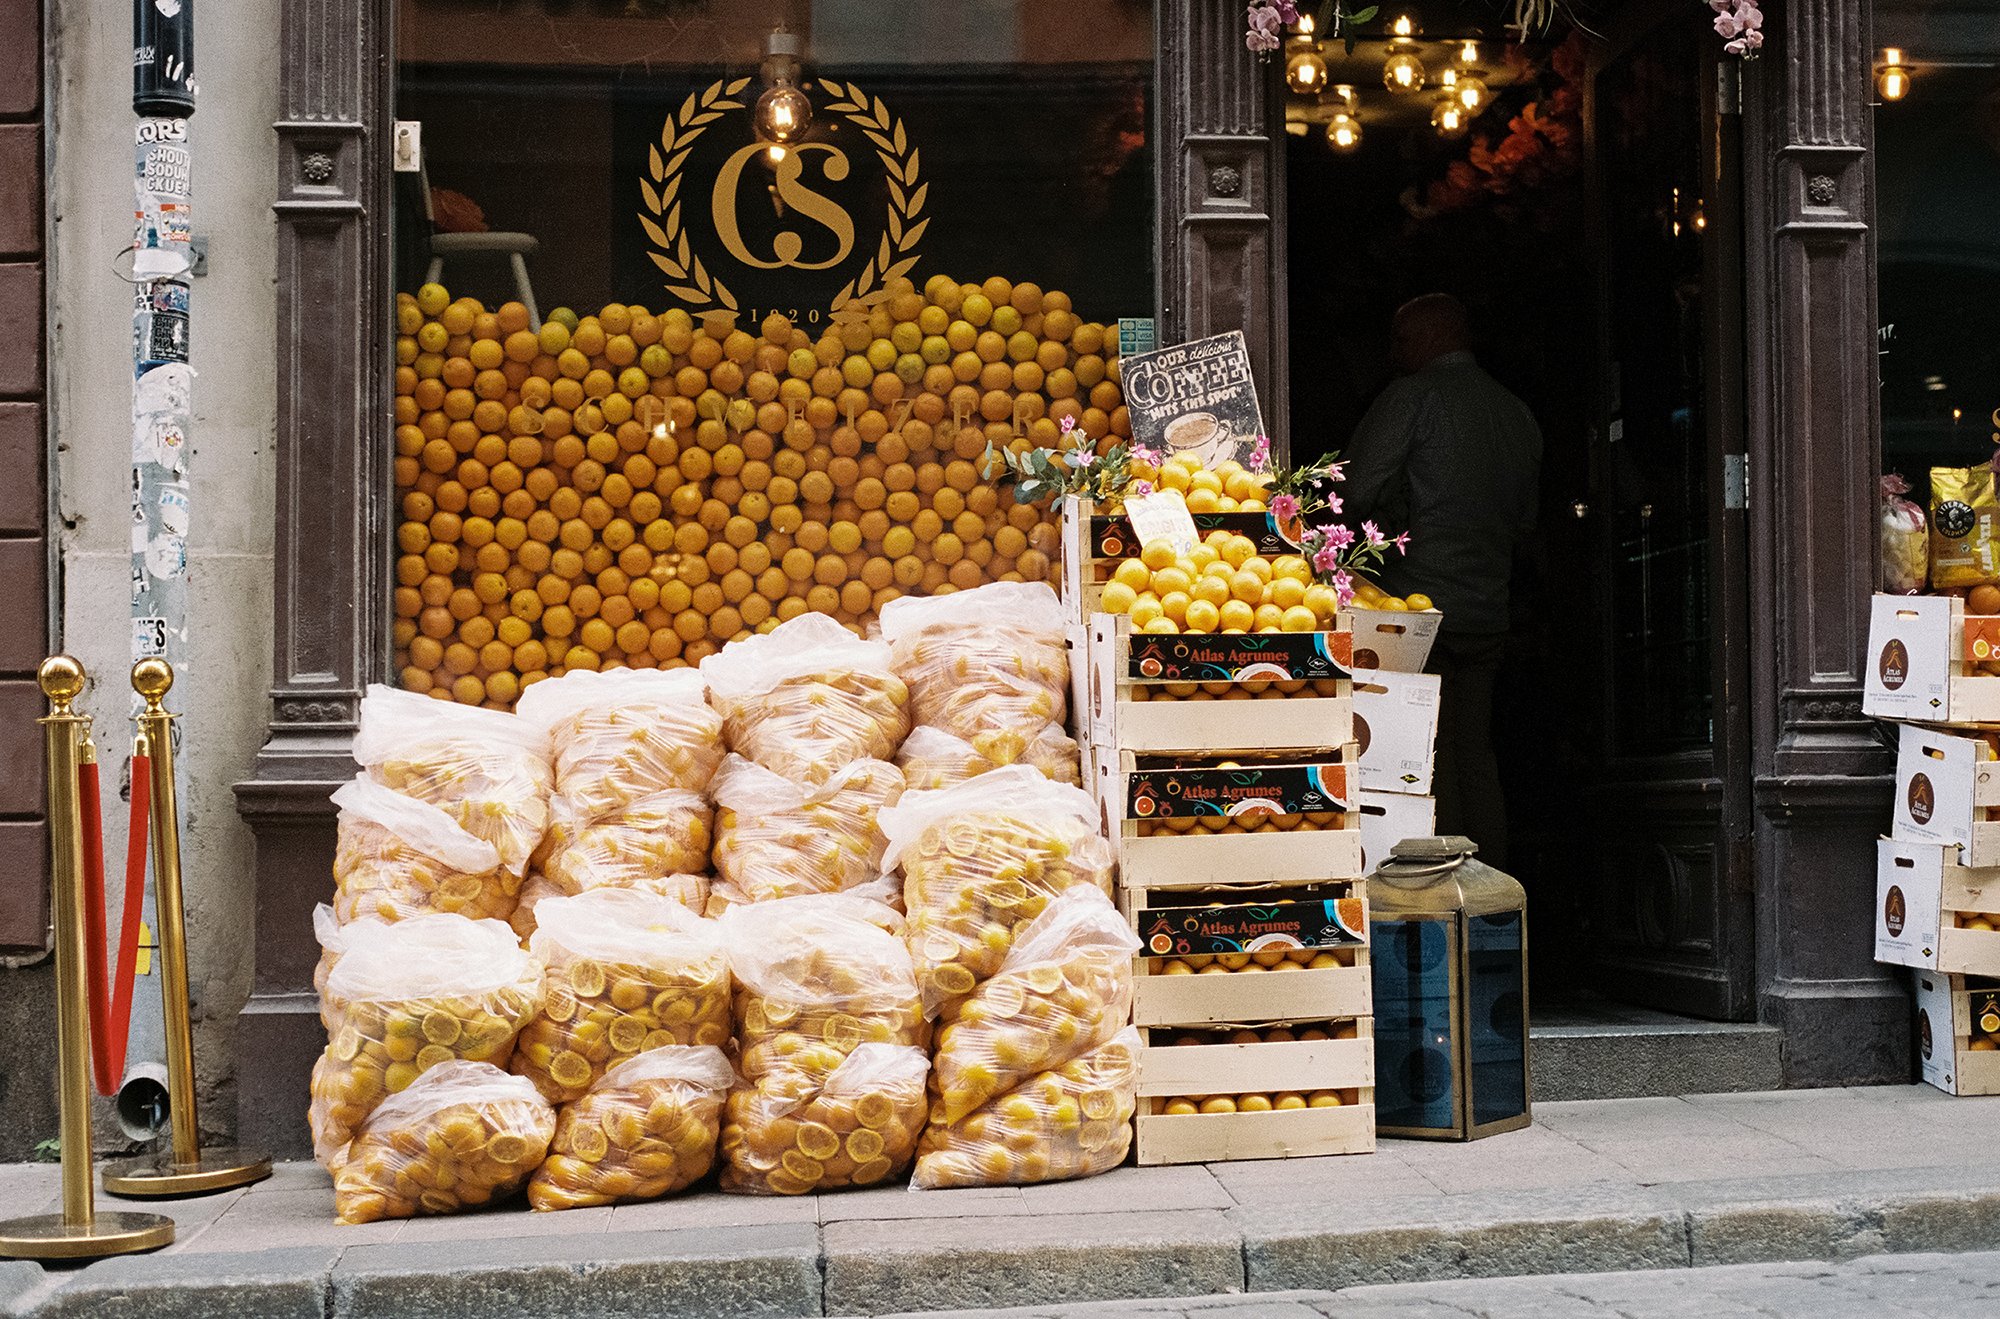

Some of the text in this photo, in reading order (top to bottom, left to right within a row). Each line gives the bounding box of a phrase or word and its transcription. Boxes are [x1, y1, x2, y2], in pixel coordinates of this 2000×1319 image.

[712, 142, 855, 270] CS
[1157, 341, 1233, 369] OUR delicious
[1126, 350, 1249, 410] COFFEE
[1182, 394, 1207, 411] THE
[522, 394, 1041, 437] SCHWEIZER
[1190, 648, 1289, 665] Atlas Agrumes
[1182, 783, 1283, 800] Atlas Agrumes
[1200, 919, 1301, 936] Atlas Agrumes
